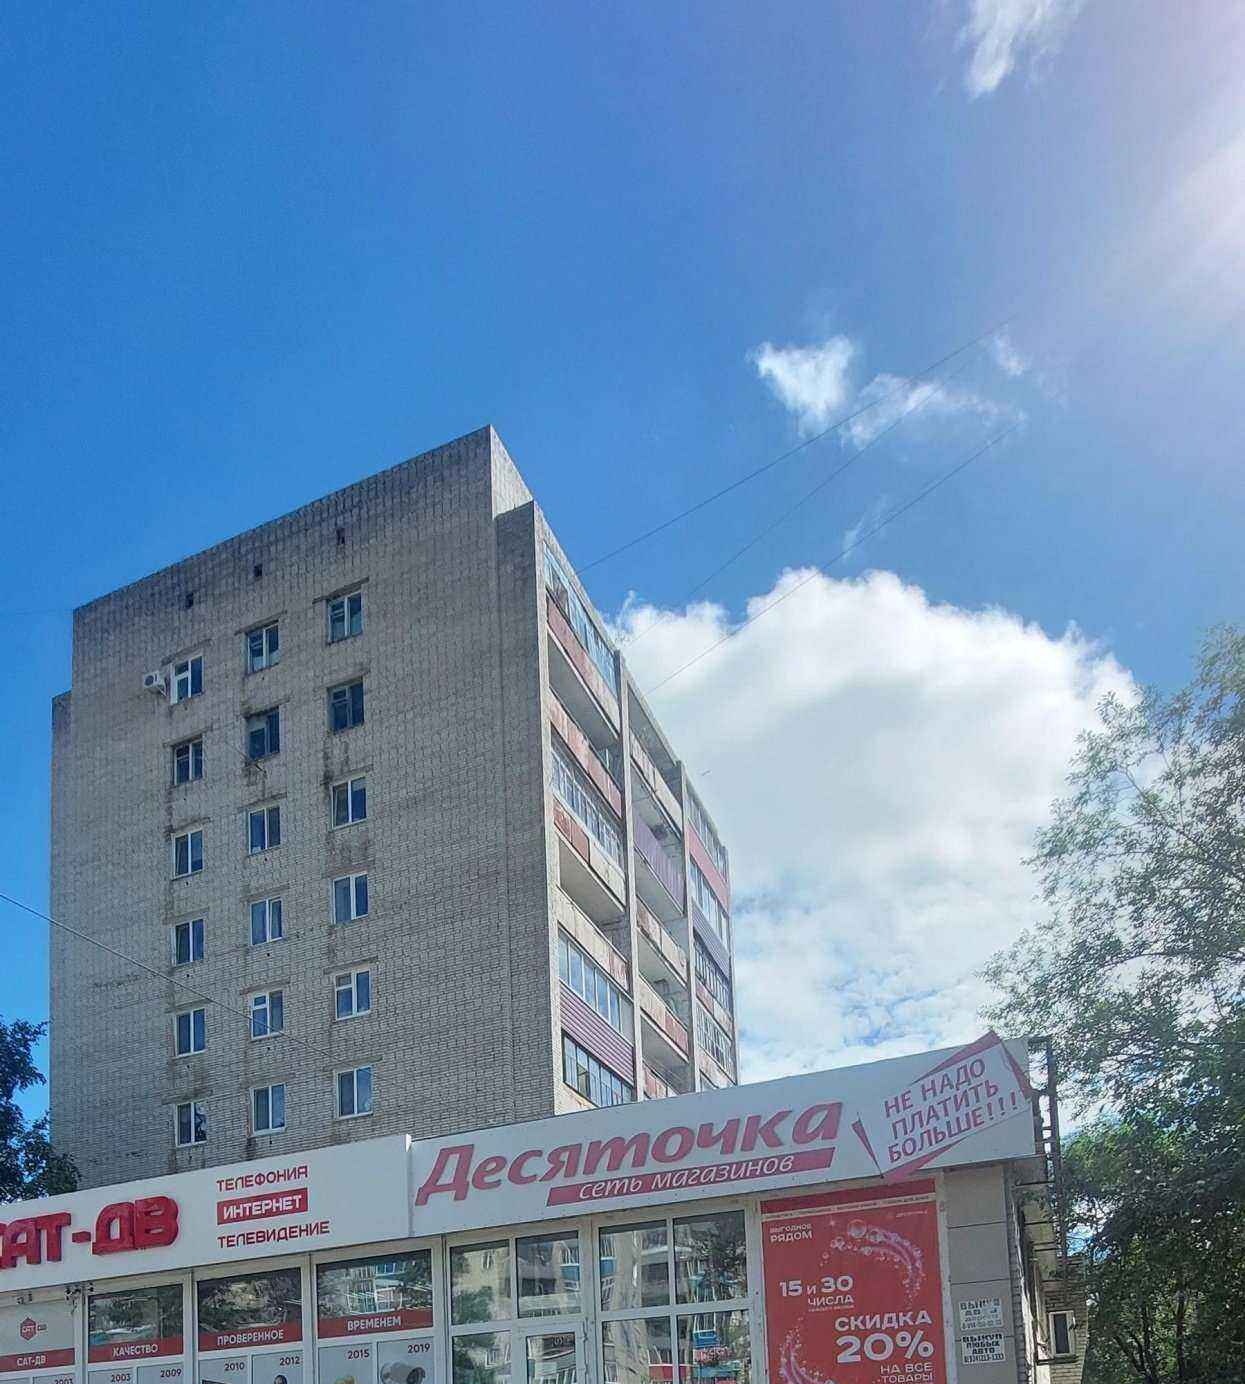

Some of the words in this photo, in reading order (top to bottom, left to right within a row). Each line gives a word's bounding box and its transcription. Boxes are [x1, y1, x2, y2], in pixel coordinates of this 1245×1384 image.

[884, 1089, 914, 1119] НЕ
[920, 1058, 986, 1101] НАДО
[892, 1079, 999, 1140] ПЛАТИТЬ
[888, 1090, 1019, 1164] БОЛЬШЕ!!!
[414, 1101, 844, 1207] Десяточка
[216, 1165, 308, 1193] ТЕЛЕФОНИЯ
[579, 1179, 643, 1201] сеть
[650, 1155, 795, 1191] магазинов
[223, 1195, 303, 1218] ИНТЕРНЕТ
[216, 1220, 331, 1249] ТЕЛЕВИДЕНИЕ
[770, 1231, 813, 1243] РЯДОМ
[779, 1280, 803, 1297] 15
[821, 1275, 854, 1293] 30
[808, 1294, 854, 1306] ЧИСЛА
[347, 1316, 401, 1331] ВРЕМЕНЕМ
[834, 1310, 933, 1332] СКИДКА
[217, 1329, 284, 1346] ПРОВЕРЕННОЕ
[112, 1343, 159, 1357] КАЧЕСТВО
[407, 1343, 431, 1354] 2019
[836, 1330, 934, 1363] 20%
[16, 1355, 47, 1367] САТ-ДВ
[279, 1356, 300, 1367] 2012
[347, 1349, 370, 1360] 2015
[160, 1368, 182, 1378] 2009
[224, 1362, 245, 1372] 2010
[880, 1364, 900, 1374] НА
[905, 1362, 933, 1373] ВСЕ
[110, 1374, 131, 1383] 2003
[881, 1372, 933, 1384] ТОВАРЫ
